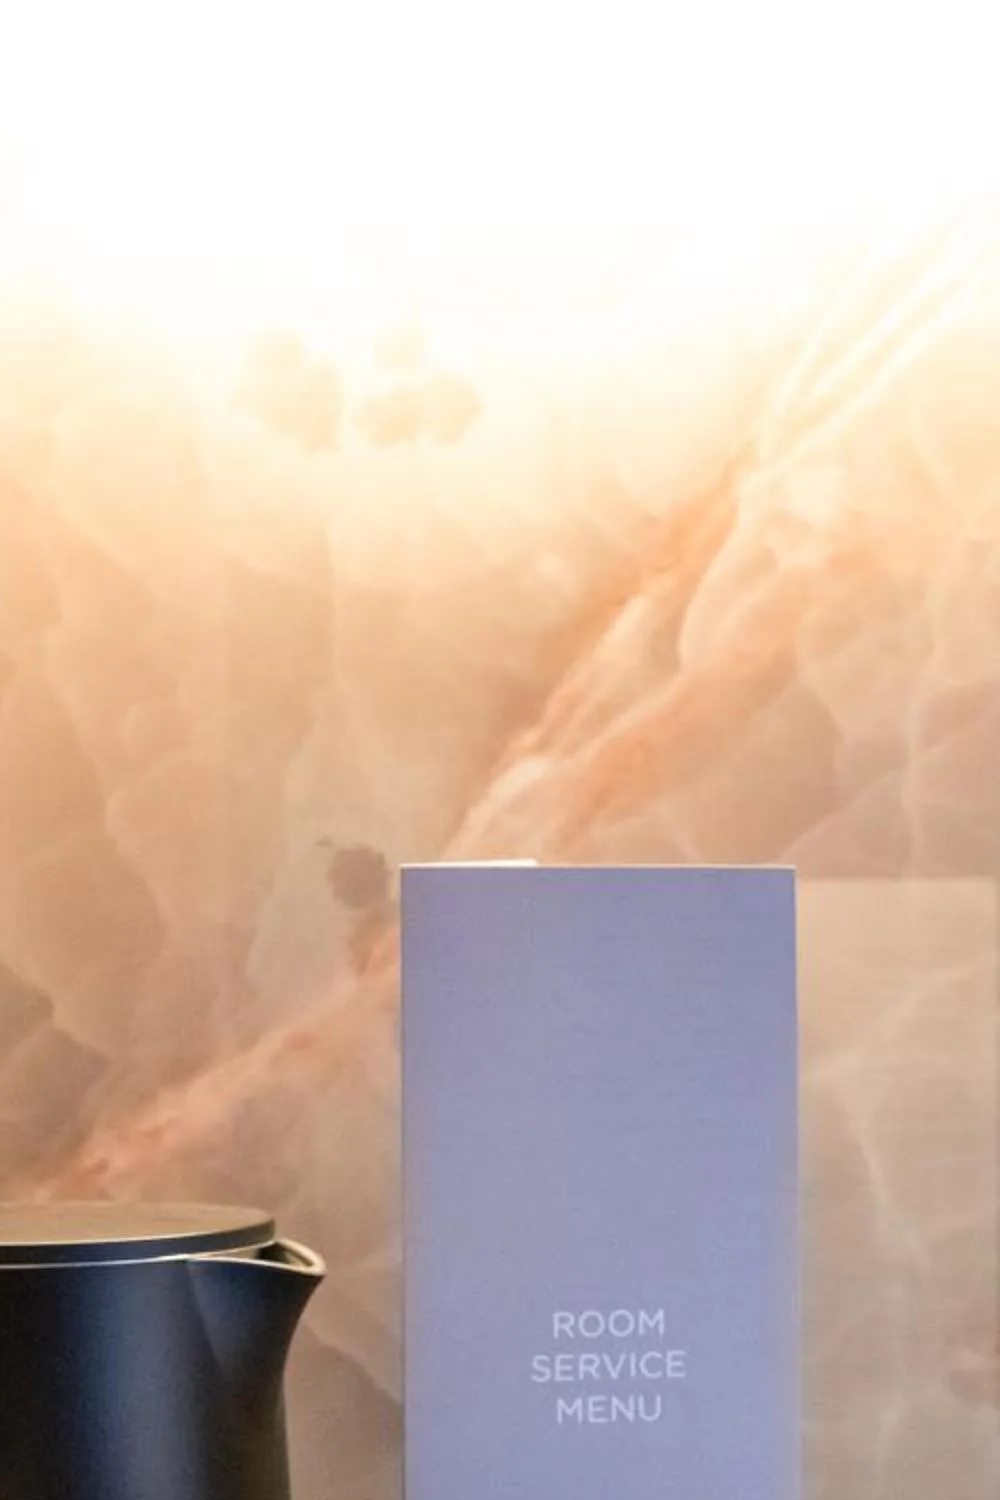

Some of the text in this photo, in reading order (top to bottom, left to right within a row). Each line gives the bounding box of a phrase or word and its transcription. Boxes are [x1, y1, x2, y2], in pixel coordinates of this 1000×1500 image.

[552, 1309, 665, 1338] ROOM
[531, 1350, 687, 1382] SERVICE
[556, 1395, 662, 1423] MENU
